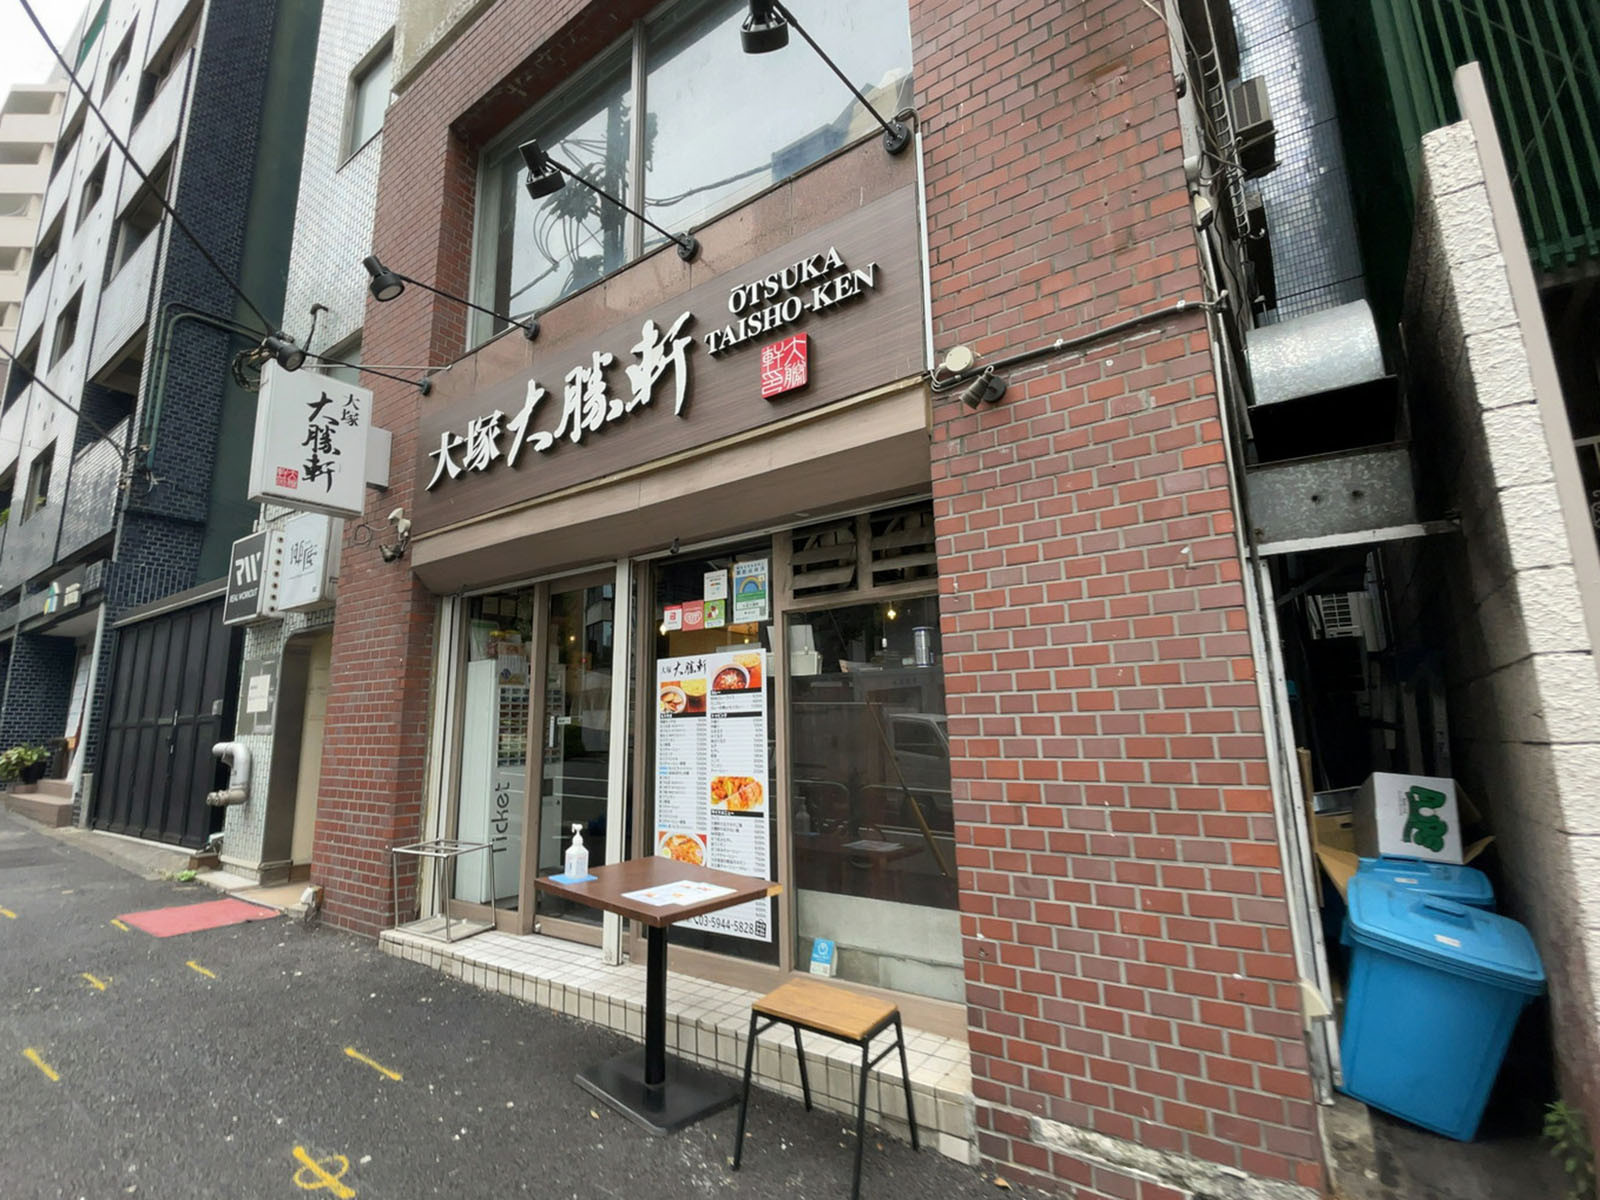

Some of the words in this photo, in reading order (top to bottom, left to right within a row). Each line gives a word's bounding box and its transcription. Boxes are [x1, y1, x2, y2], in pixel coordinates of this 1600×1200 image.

[704, 262, 878, 356] TAISHO-KEN
[301, 391, 340, 493] 大勝軒
[699, 916, 755, 935] 03-5944-5828
